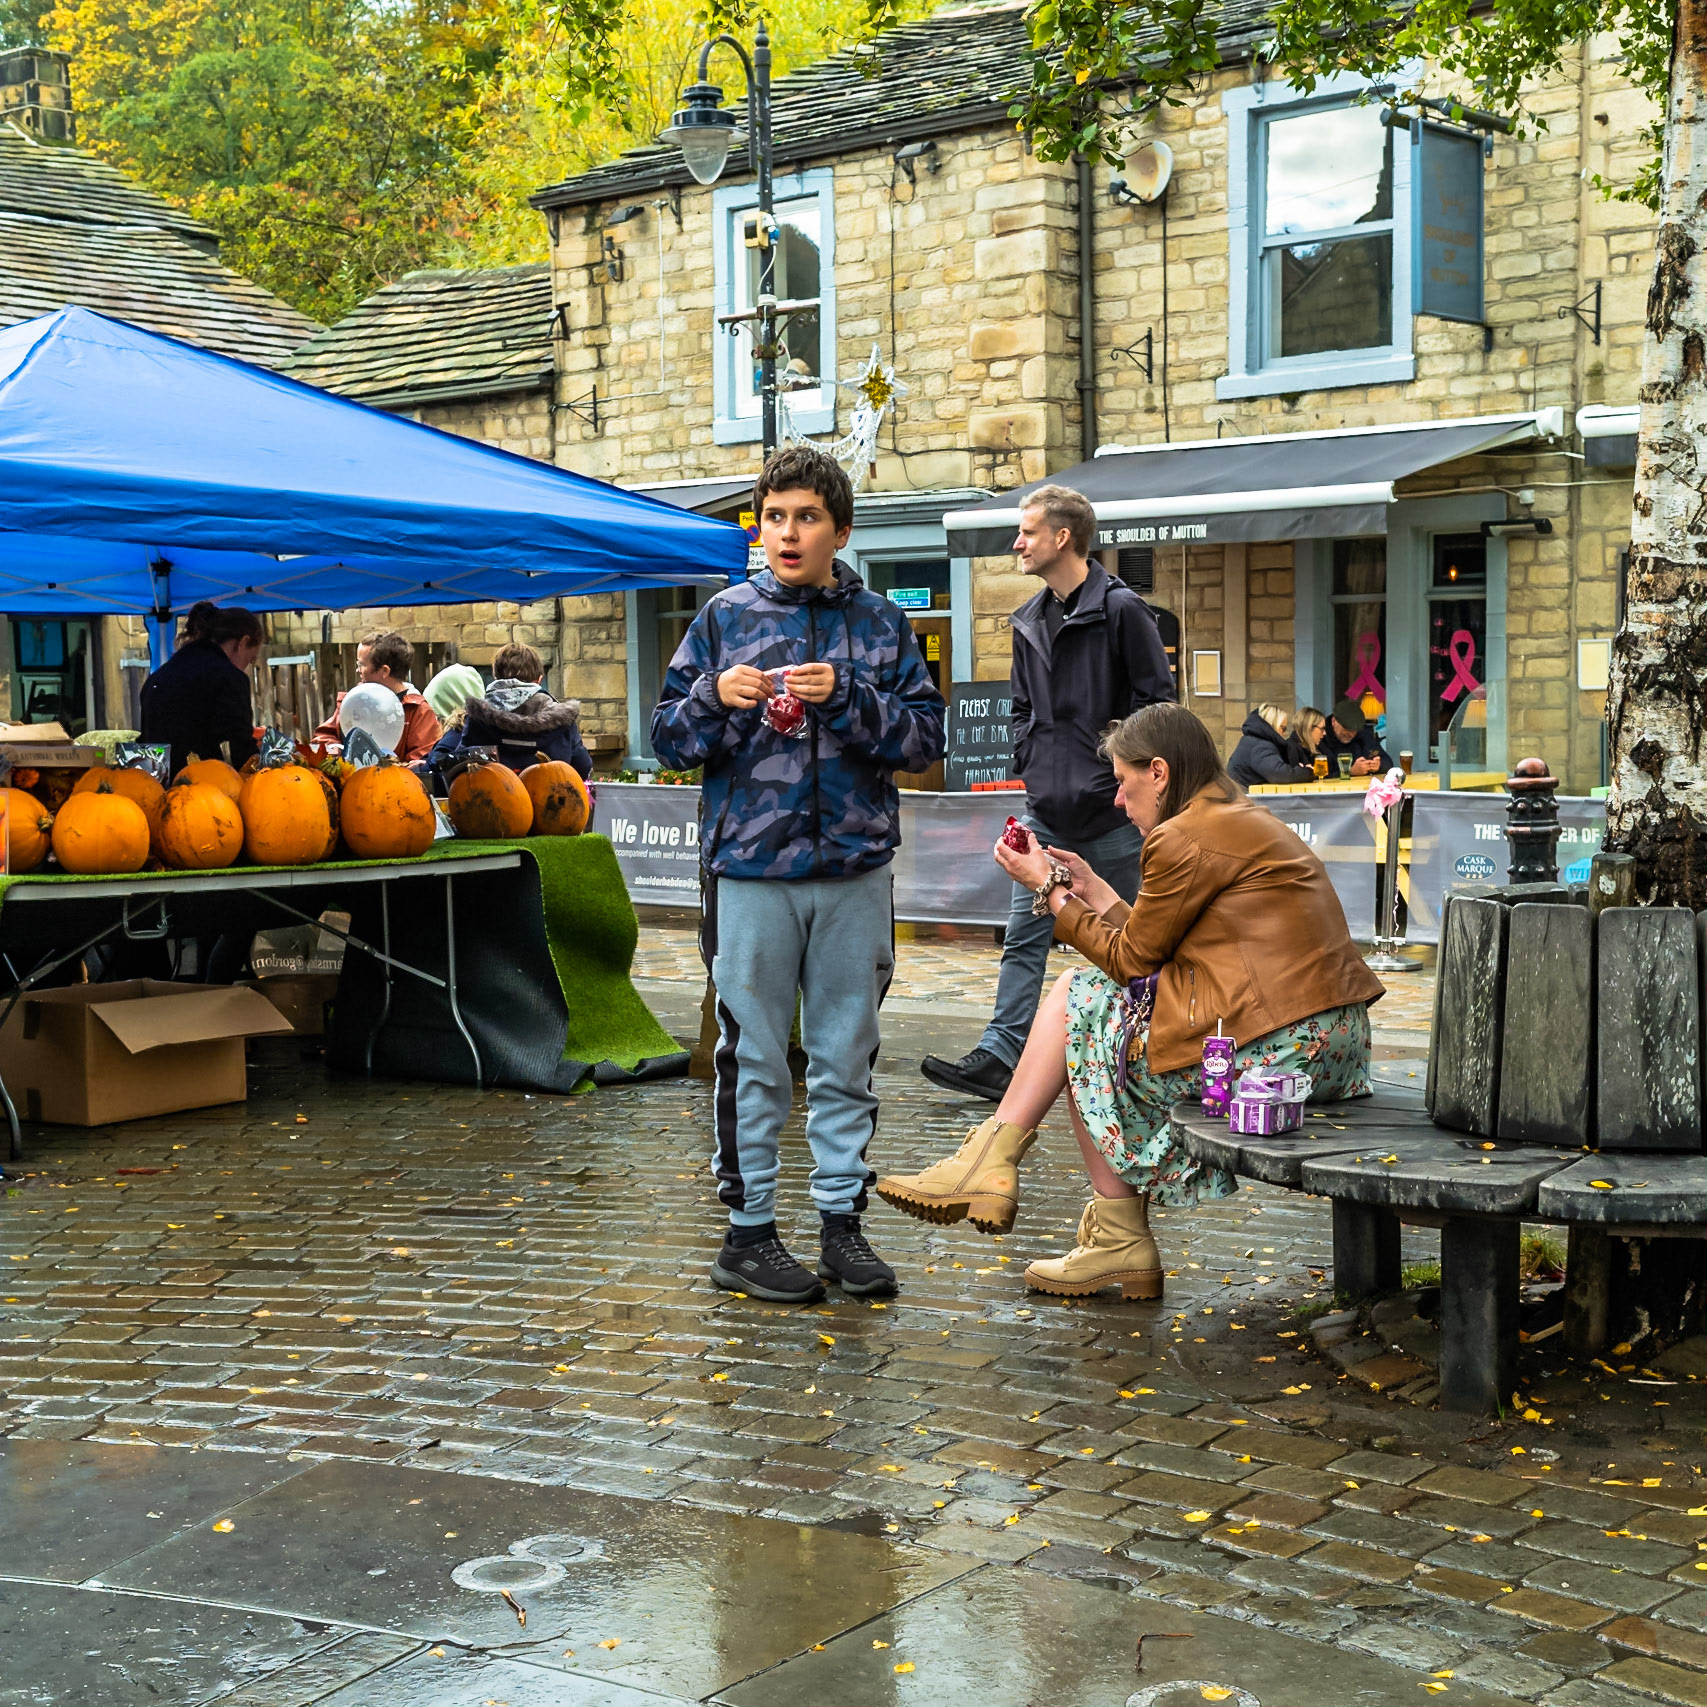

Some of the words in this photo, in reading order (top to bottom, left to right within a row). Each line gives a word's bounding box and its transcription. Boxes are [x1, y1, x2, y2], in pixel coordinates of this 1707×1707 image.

[1099, 530, 1114, 544] THE
[1116, 527, 1156, 543] SHOULDER
[1158, 526, 1170, 540] OF
[1172, 523, 1207, 540] MUTTON
[959, 698, 991, 718] PLEASE
[611, 818, 638, 844] We
[641, 819, 681, 847] love
[684, 821, 700, 847] D
[1473, 823, 1501, 840] THE
[1581, 827, 1600, 844] OF
[1456, 864, 1495, 874] MARQUE
[1463, 856, 1486, 865] CASK
